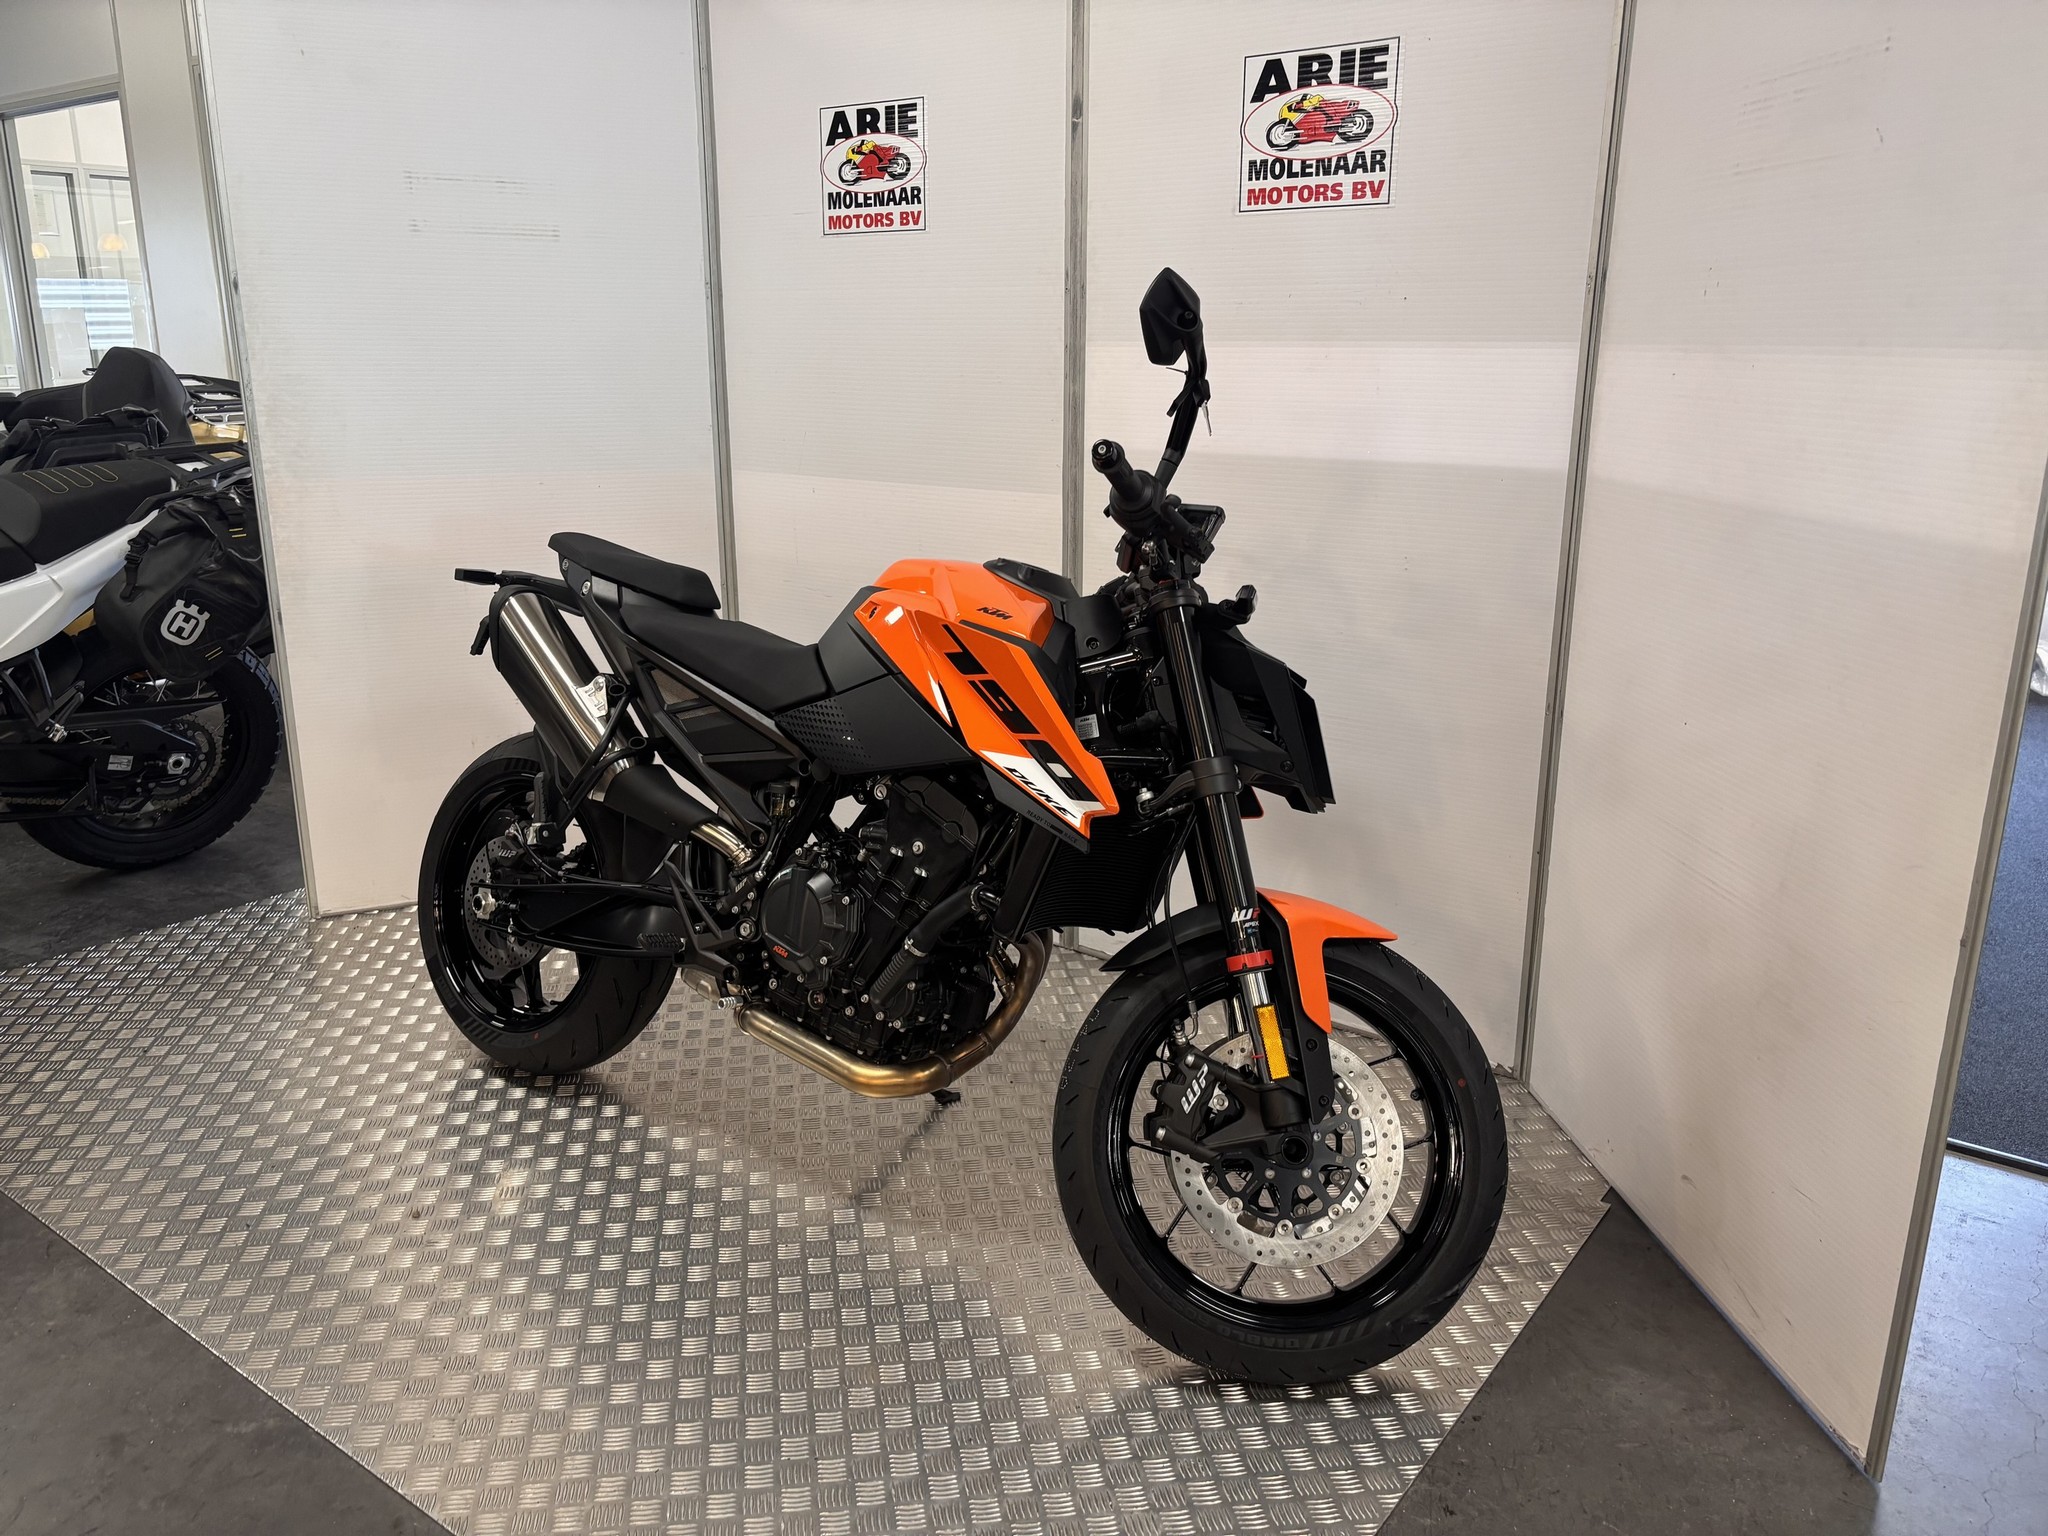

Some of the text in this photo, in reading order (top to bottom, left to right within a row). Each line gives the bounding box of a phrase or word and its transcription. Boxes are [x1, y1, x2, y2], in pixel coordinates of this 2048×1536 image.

[1250, 44, 1390, 103] ARIE
[826, 102, 918, 146] ARIE
[1247, 149, 1387, 182] MOLENAAR
[827, 186, 922, 210] MOLENAAR
[1246, 179, 1386, 206] MOTORS BV
[828, 210, 922, 230] MOTORS BV
[976, 606, 1013, 620] KTM
[1003, 766, 1078, 819] DUKE
[773, 945, 789, 958] KTM
